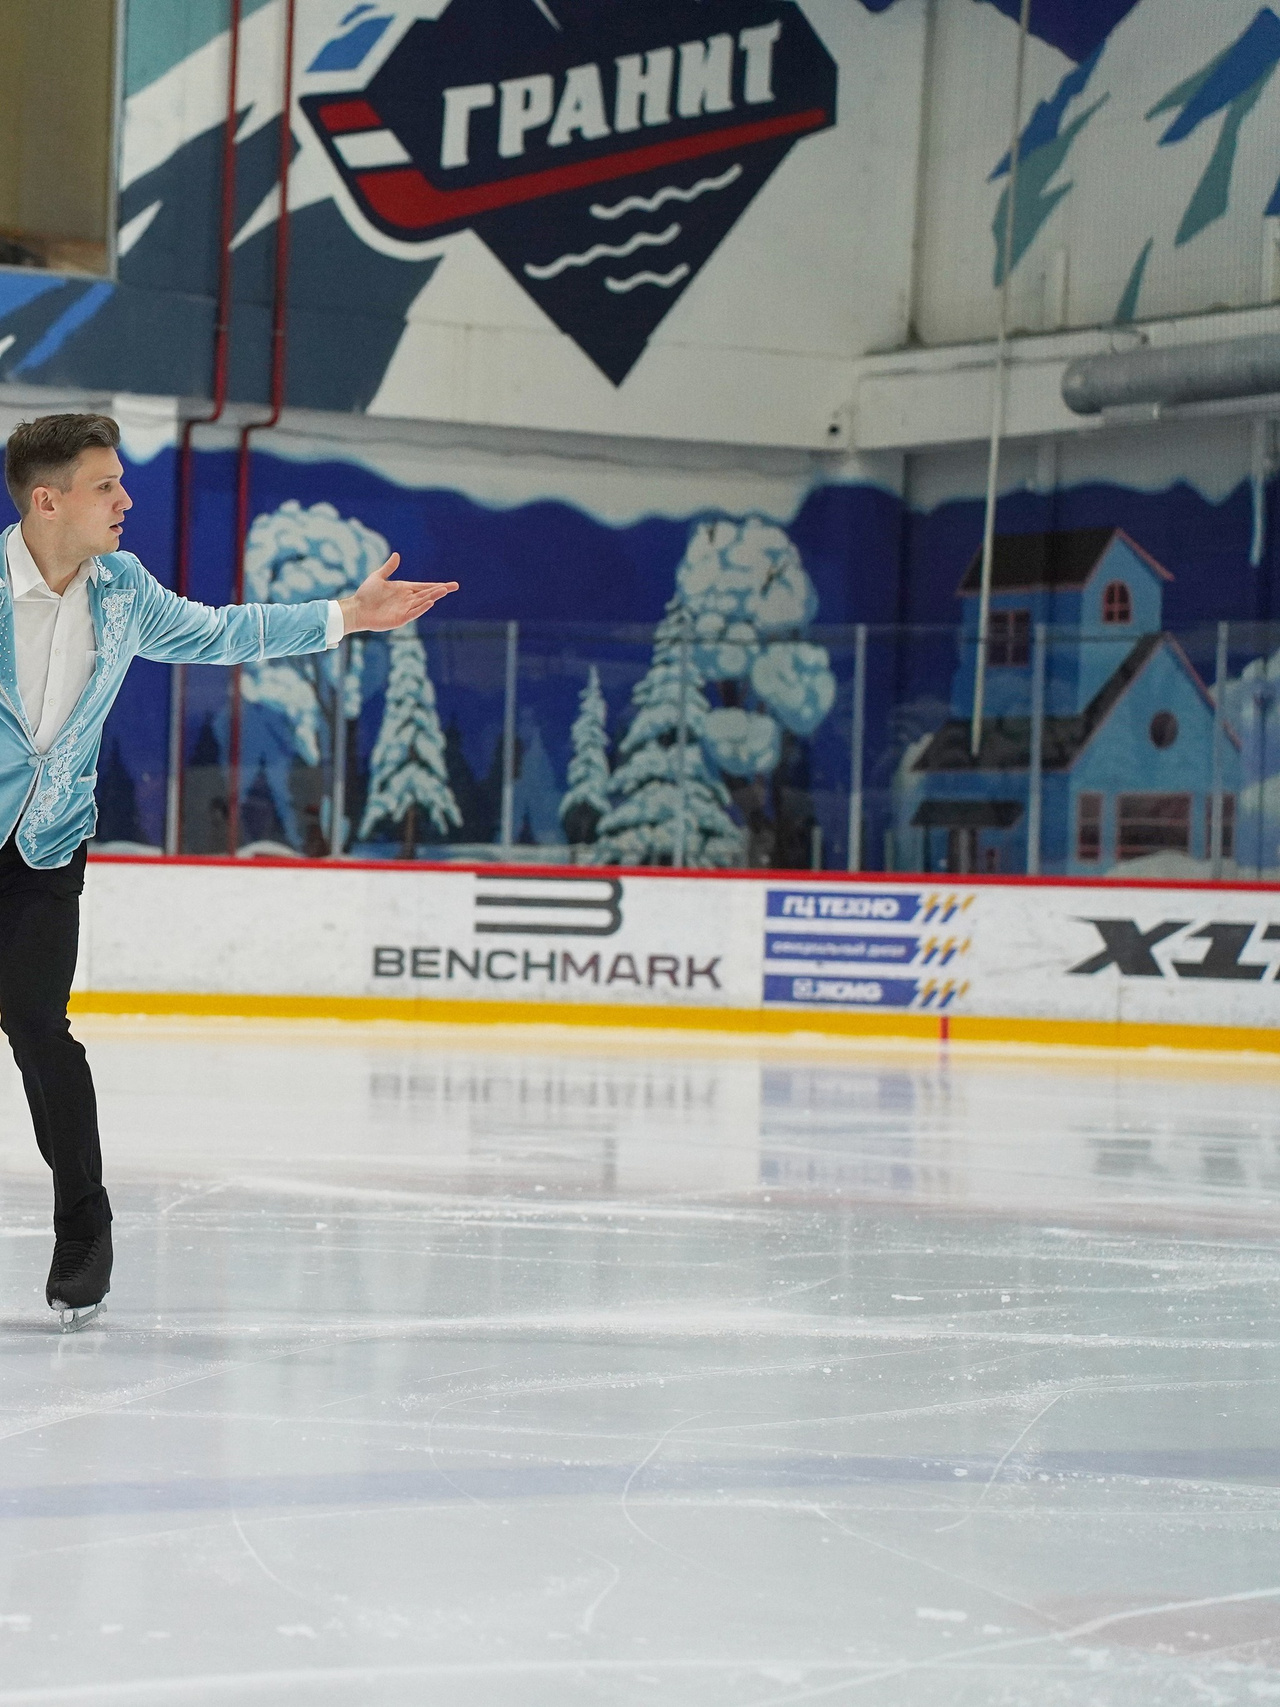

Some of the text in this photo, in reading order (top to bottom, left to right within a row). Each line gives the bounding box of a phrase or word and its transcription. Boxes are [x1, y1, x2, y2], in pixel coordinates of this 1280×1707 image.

[441, 19, 781, 169] ГРАНИТ
[373, 945, 723, 988] BENCHMARK
[1065, 916, 1280, 981] X1
